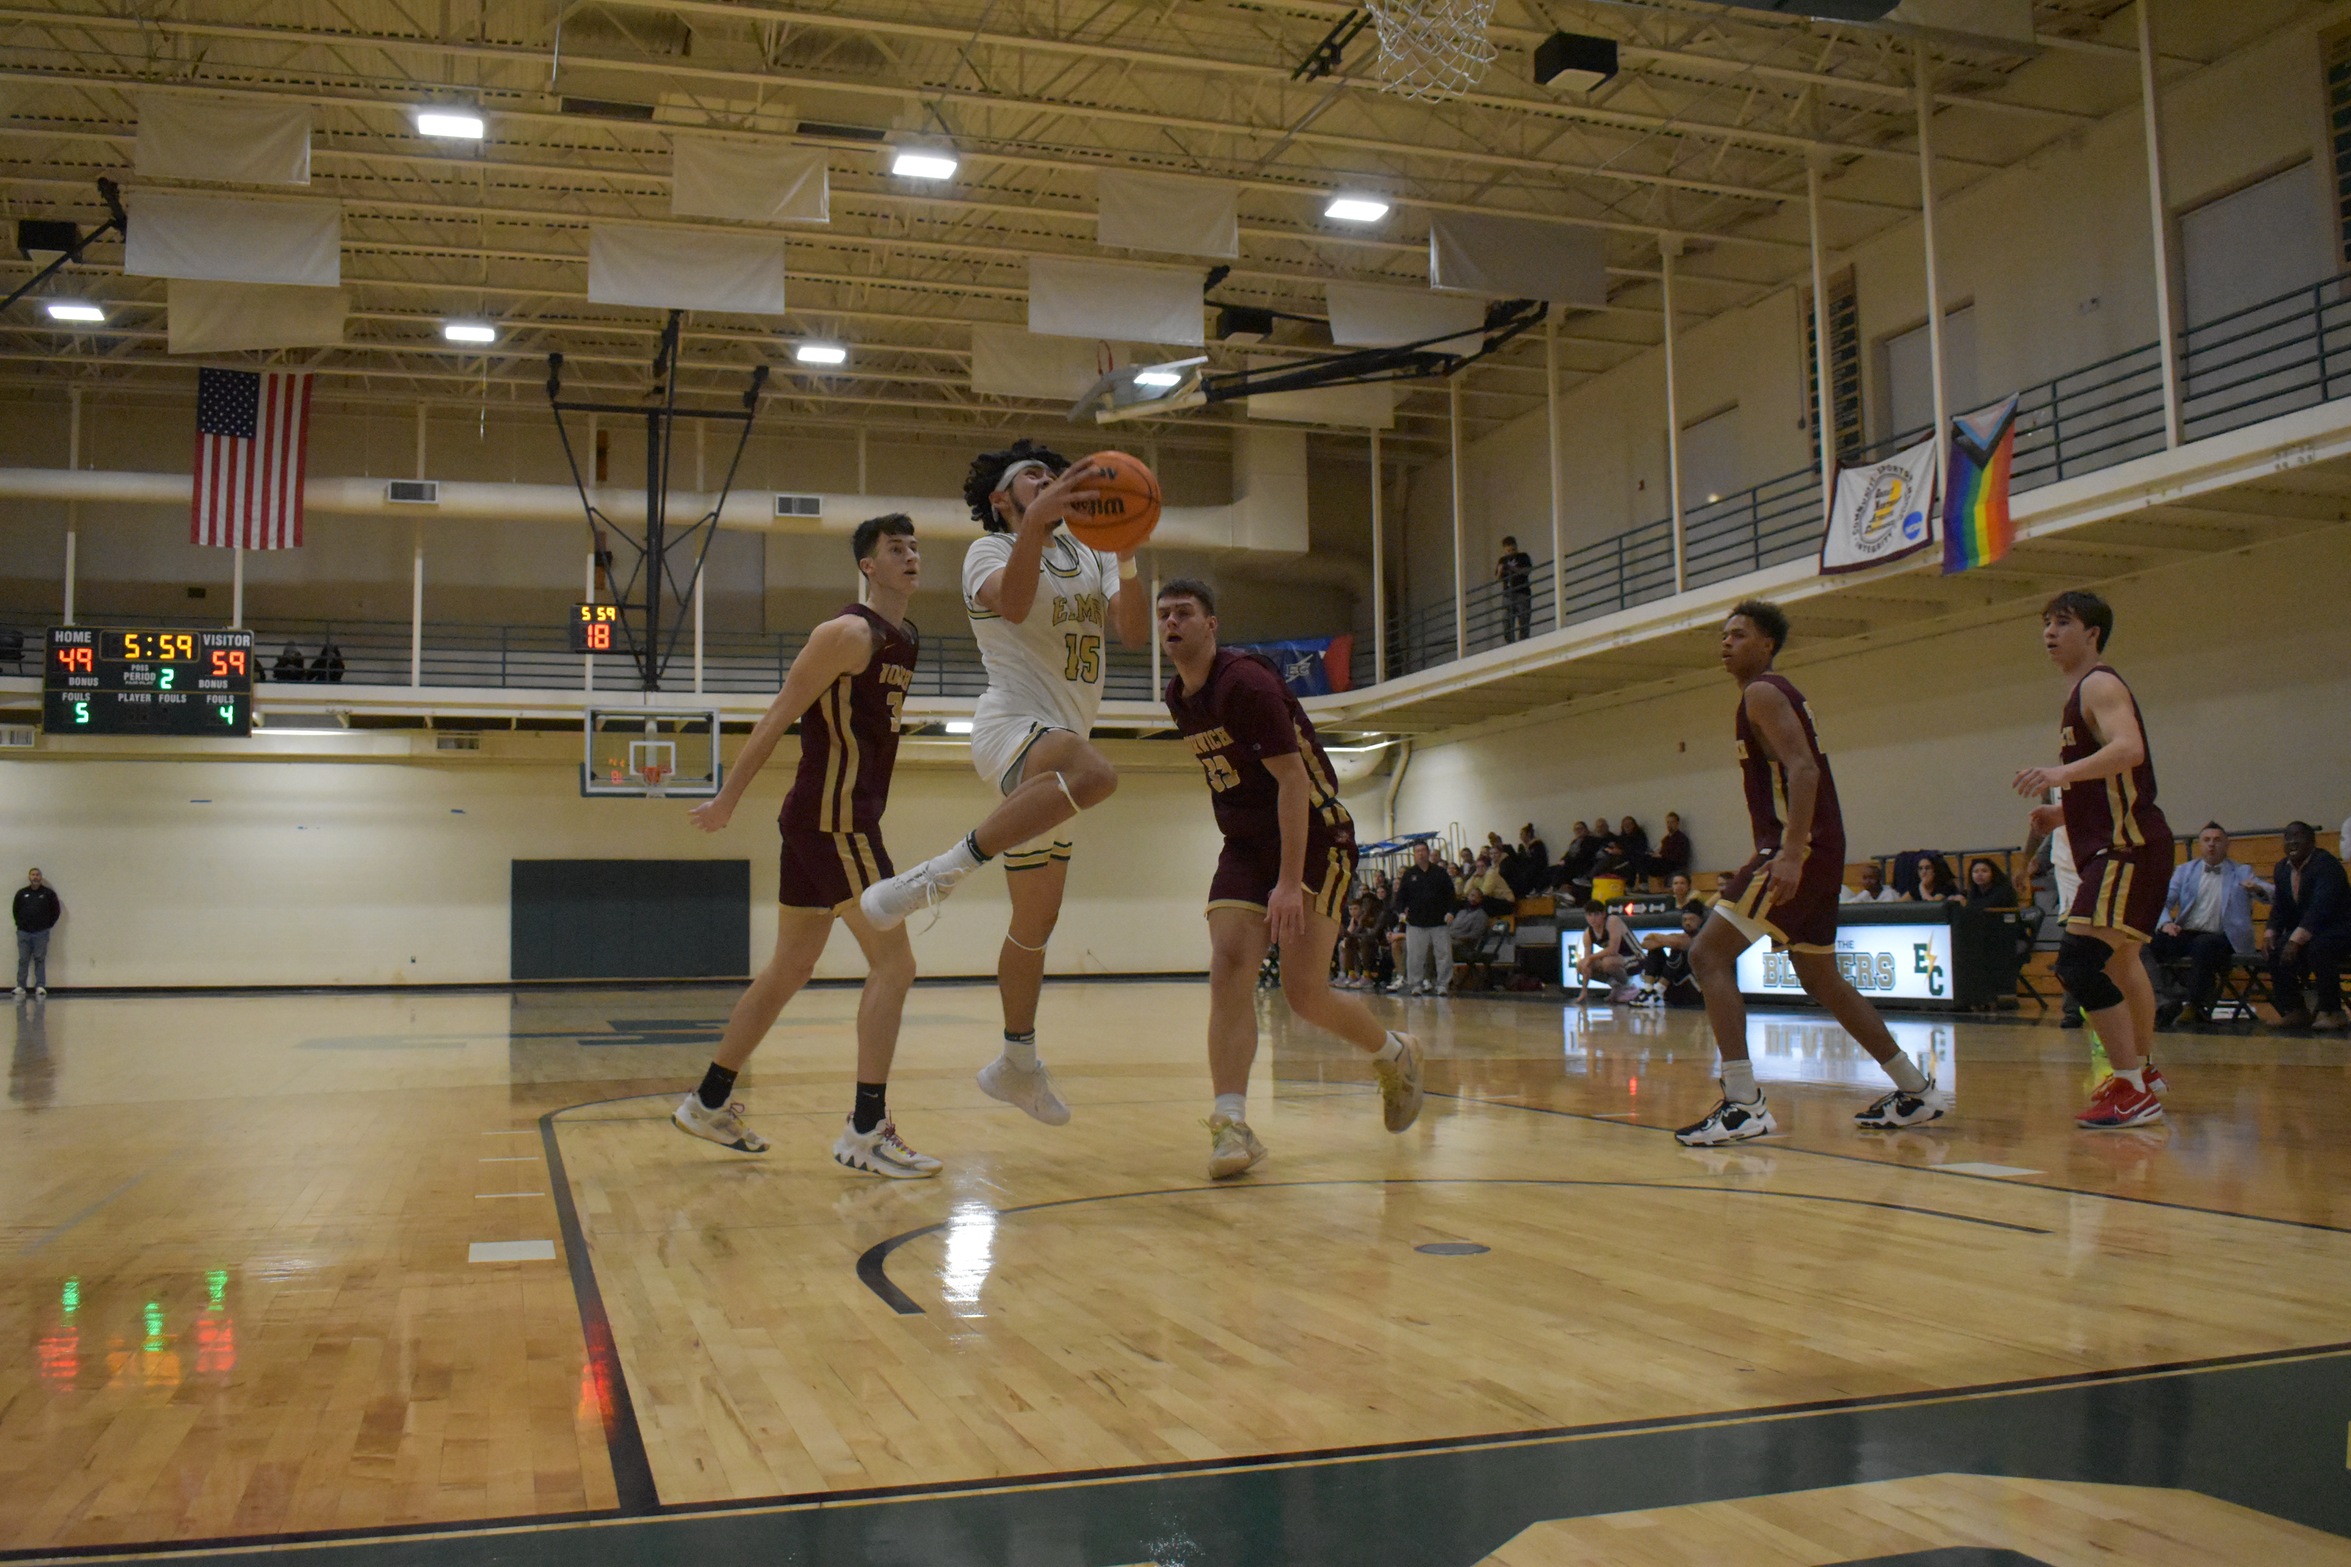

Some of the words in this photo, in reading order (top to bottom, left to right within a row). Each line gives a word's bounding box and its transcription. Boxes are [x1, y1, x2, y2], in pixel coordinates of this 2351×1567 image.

[55, 631, 92, 643] HOME
[203, 634, 250, 647] VISITOR
[587, 624, 610, 649] 18
[125, 634, 192, 659] 5:59
[59, 648, 92, 673] 49
[212, 651, 245, 676] 59
[1065, 633, 1099, 684] 15
[69, 677, 99, 687] BONUS
[123, 671, 156, 681] PERIOD
[160, 668, 175, 690] 2
[199, 680, 228, 689] BONUS
[62, 692, 91, 702] FOULS
[118, 693, 152, 703] PLAYER
[158, 694, 187, 703] FOULS
[206, 695, 235, 704] FOULS
[75, 702, 90, 724] 5
[219, 705, 234, 726] 4
[1837, 940, 1855, 949] THE
[1763, 952, 1896, 991] BLERS
